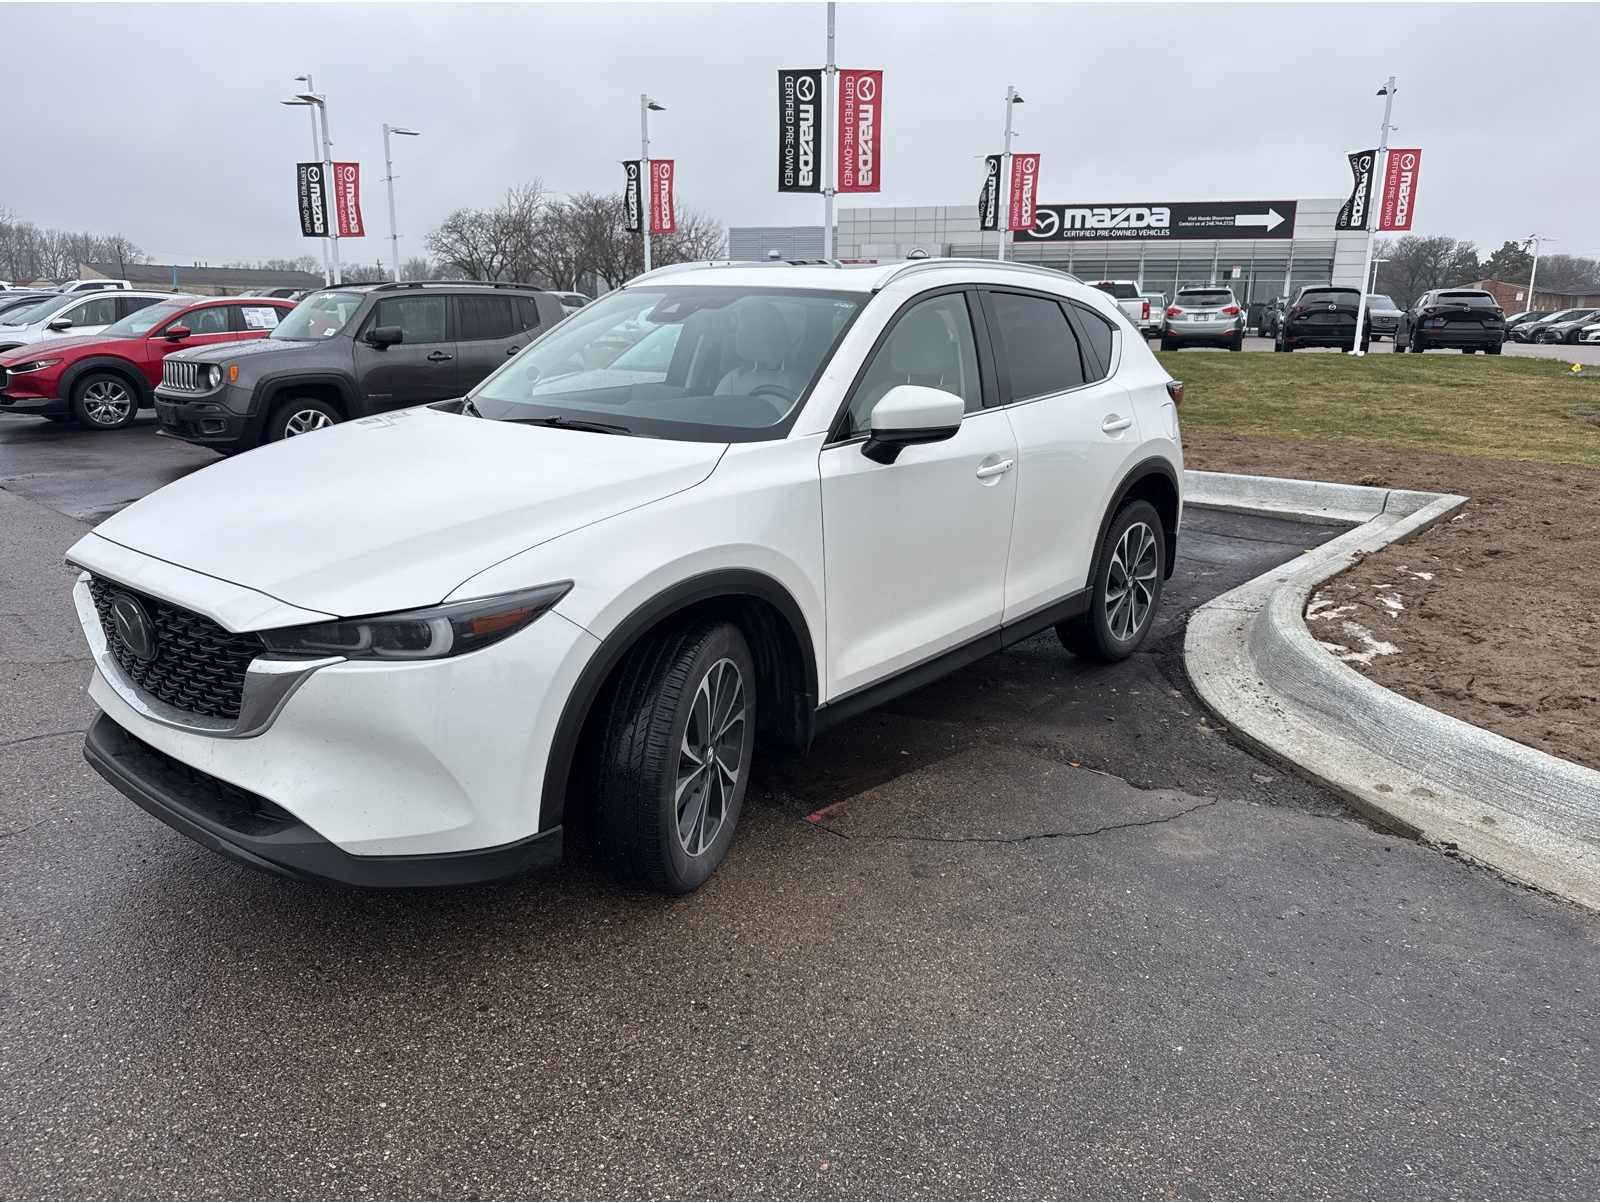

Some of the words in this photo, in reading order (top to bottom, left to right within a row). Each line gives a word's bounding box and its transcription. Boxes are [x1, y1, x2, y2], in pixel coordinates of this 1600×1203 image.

[784, 76, 794, 124] CERTIFIED
[845, 76, 854, 124] CERTIFIED
[784, 126, 794, 186] PRE-OWNED
[844, 127, 853, 186] PRE-OWNED
[1389, 153, 1400, 186] CERTIFIED
[302, 196, 312, 233] PRE-OWNED
[1383, 186, 1396, 227] PRE-OWNED
[1063, 230, 1095, 238] CERTIFIED
[1096, 229, 1137, 237] PRE-OWNED
[1138, 228, 1170, 237] VEHICLES
